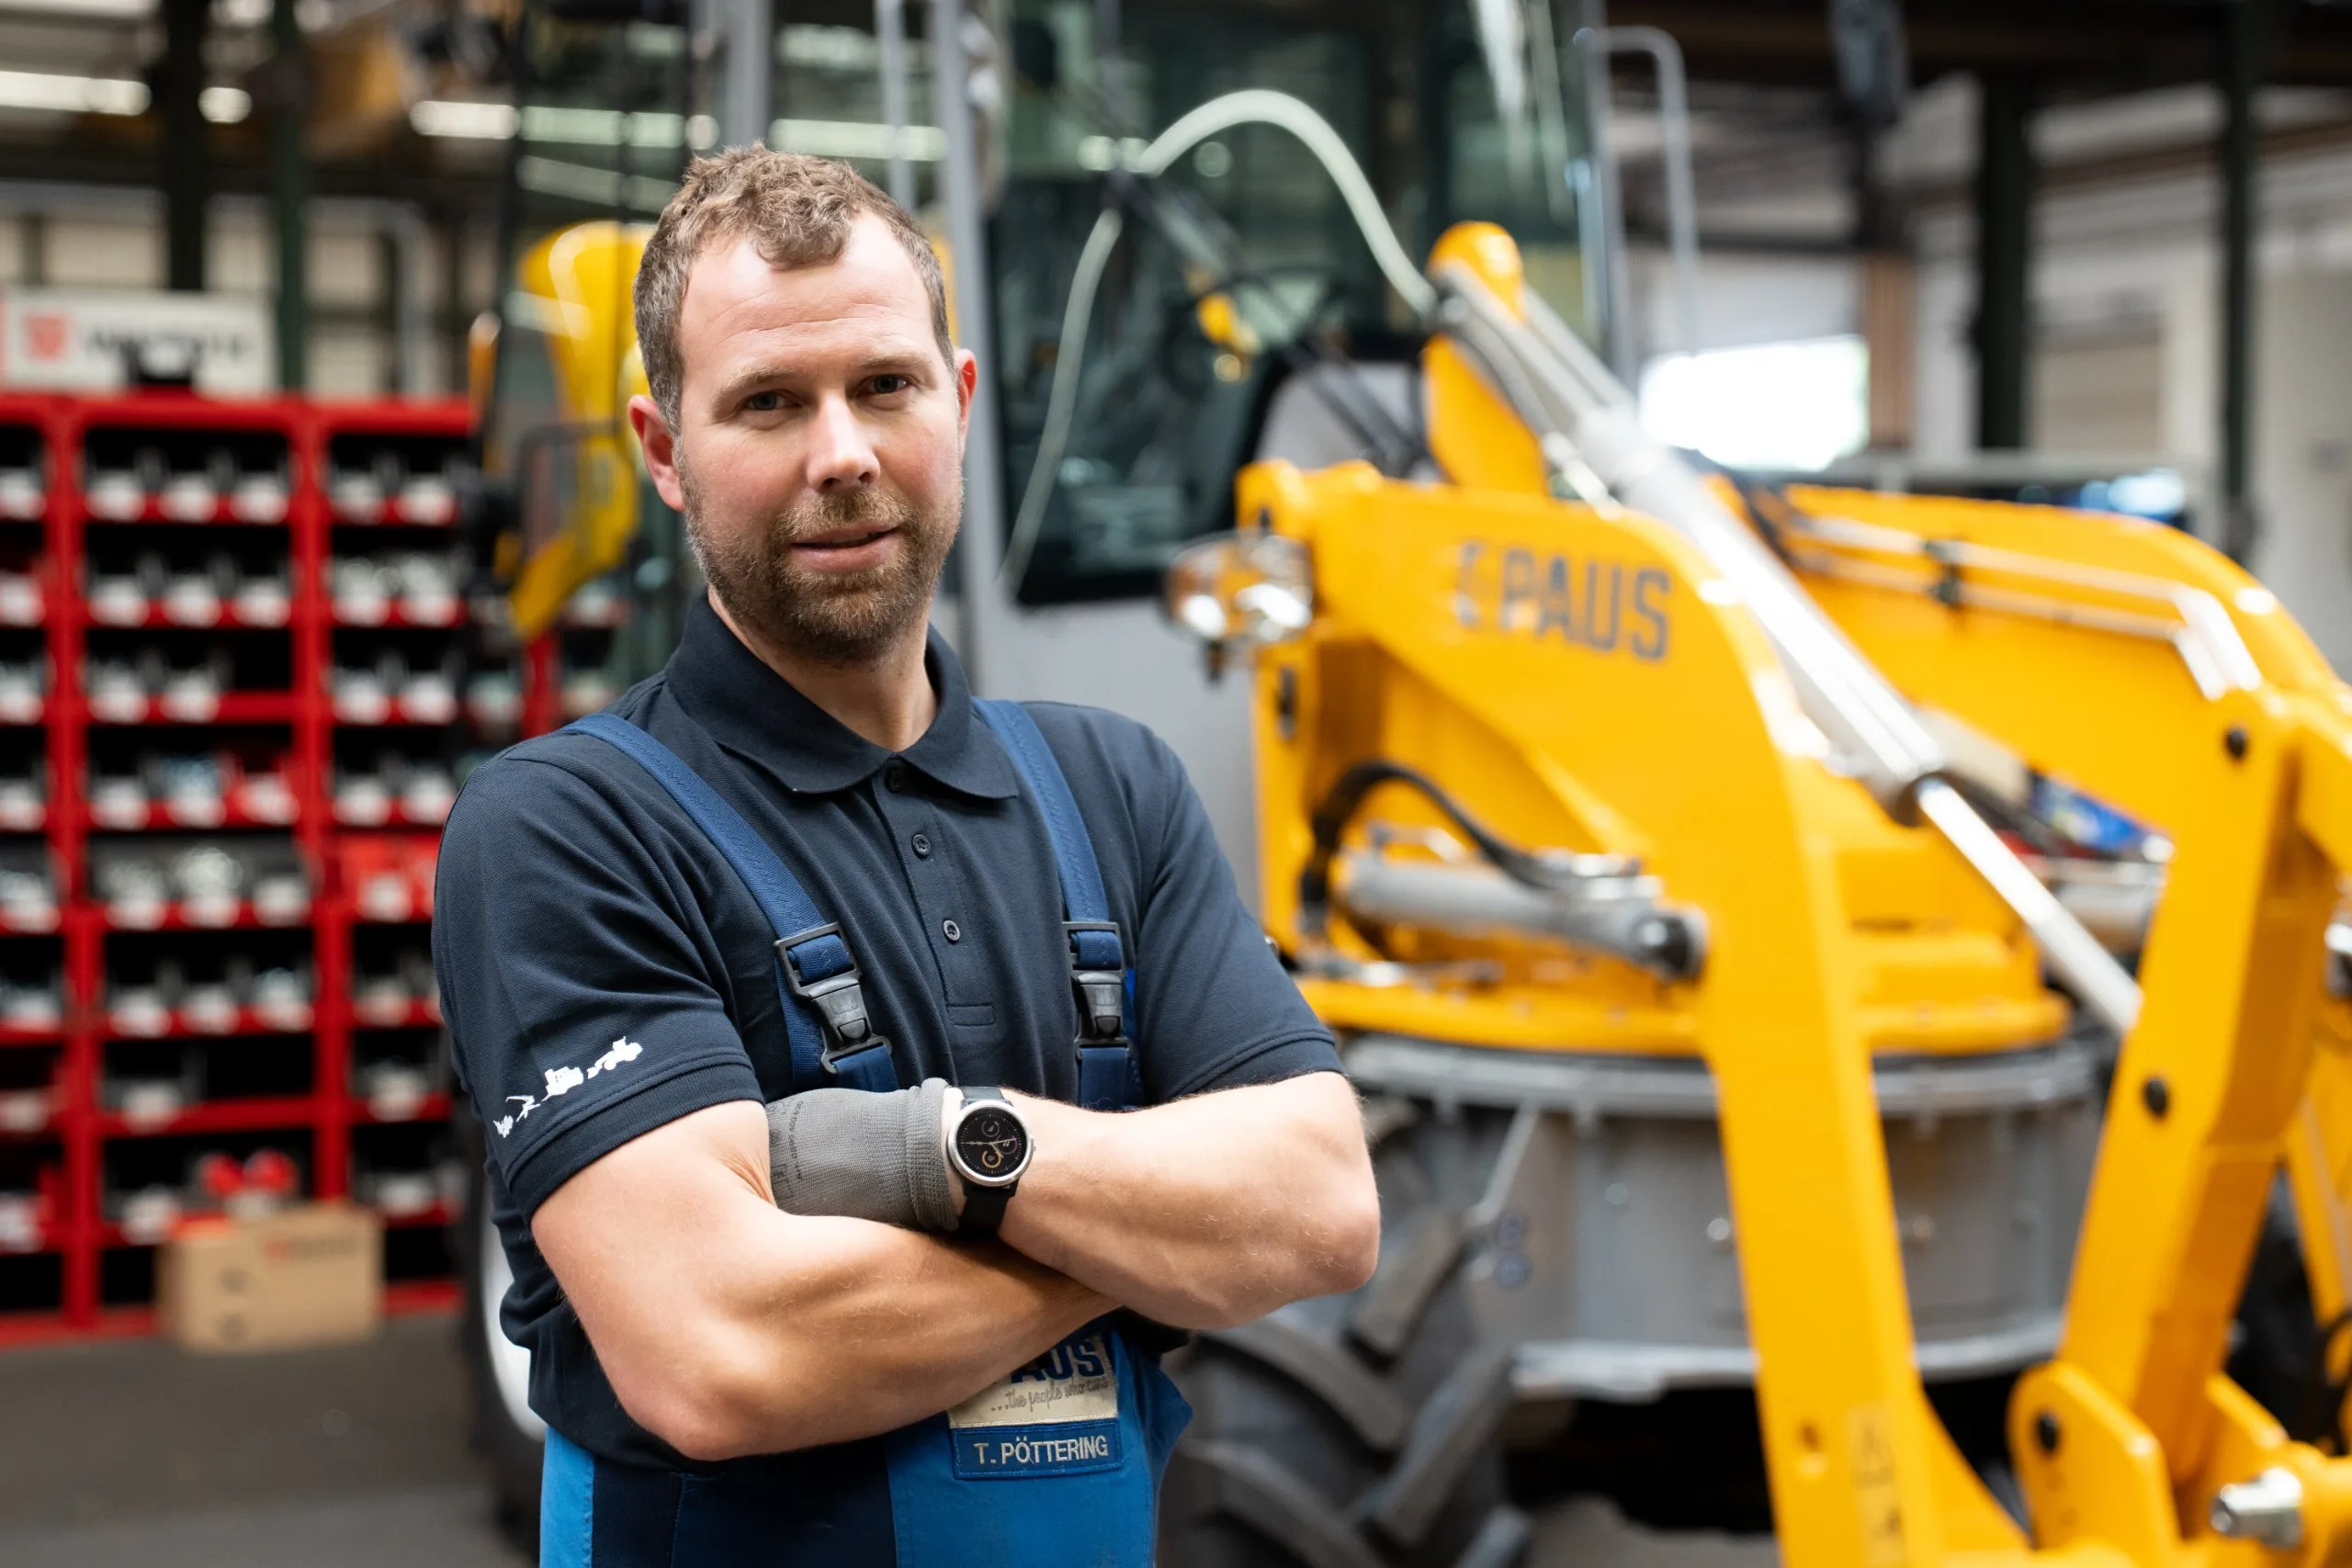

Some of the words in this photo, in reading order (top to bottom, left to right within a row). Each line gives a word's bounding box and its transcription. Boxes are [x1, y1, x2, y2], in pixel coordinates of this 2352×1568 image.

[1499, 547, 1671, 662] PAUS
[1028, 1380, 1063, 1414] people
[973, 1443, 996, 1465] T.
[1001, 1435, 1108, 1466] PÖTTERING
